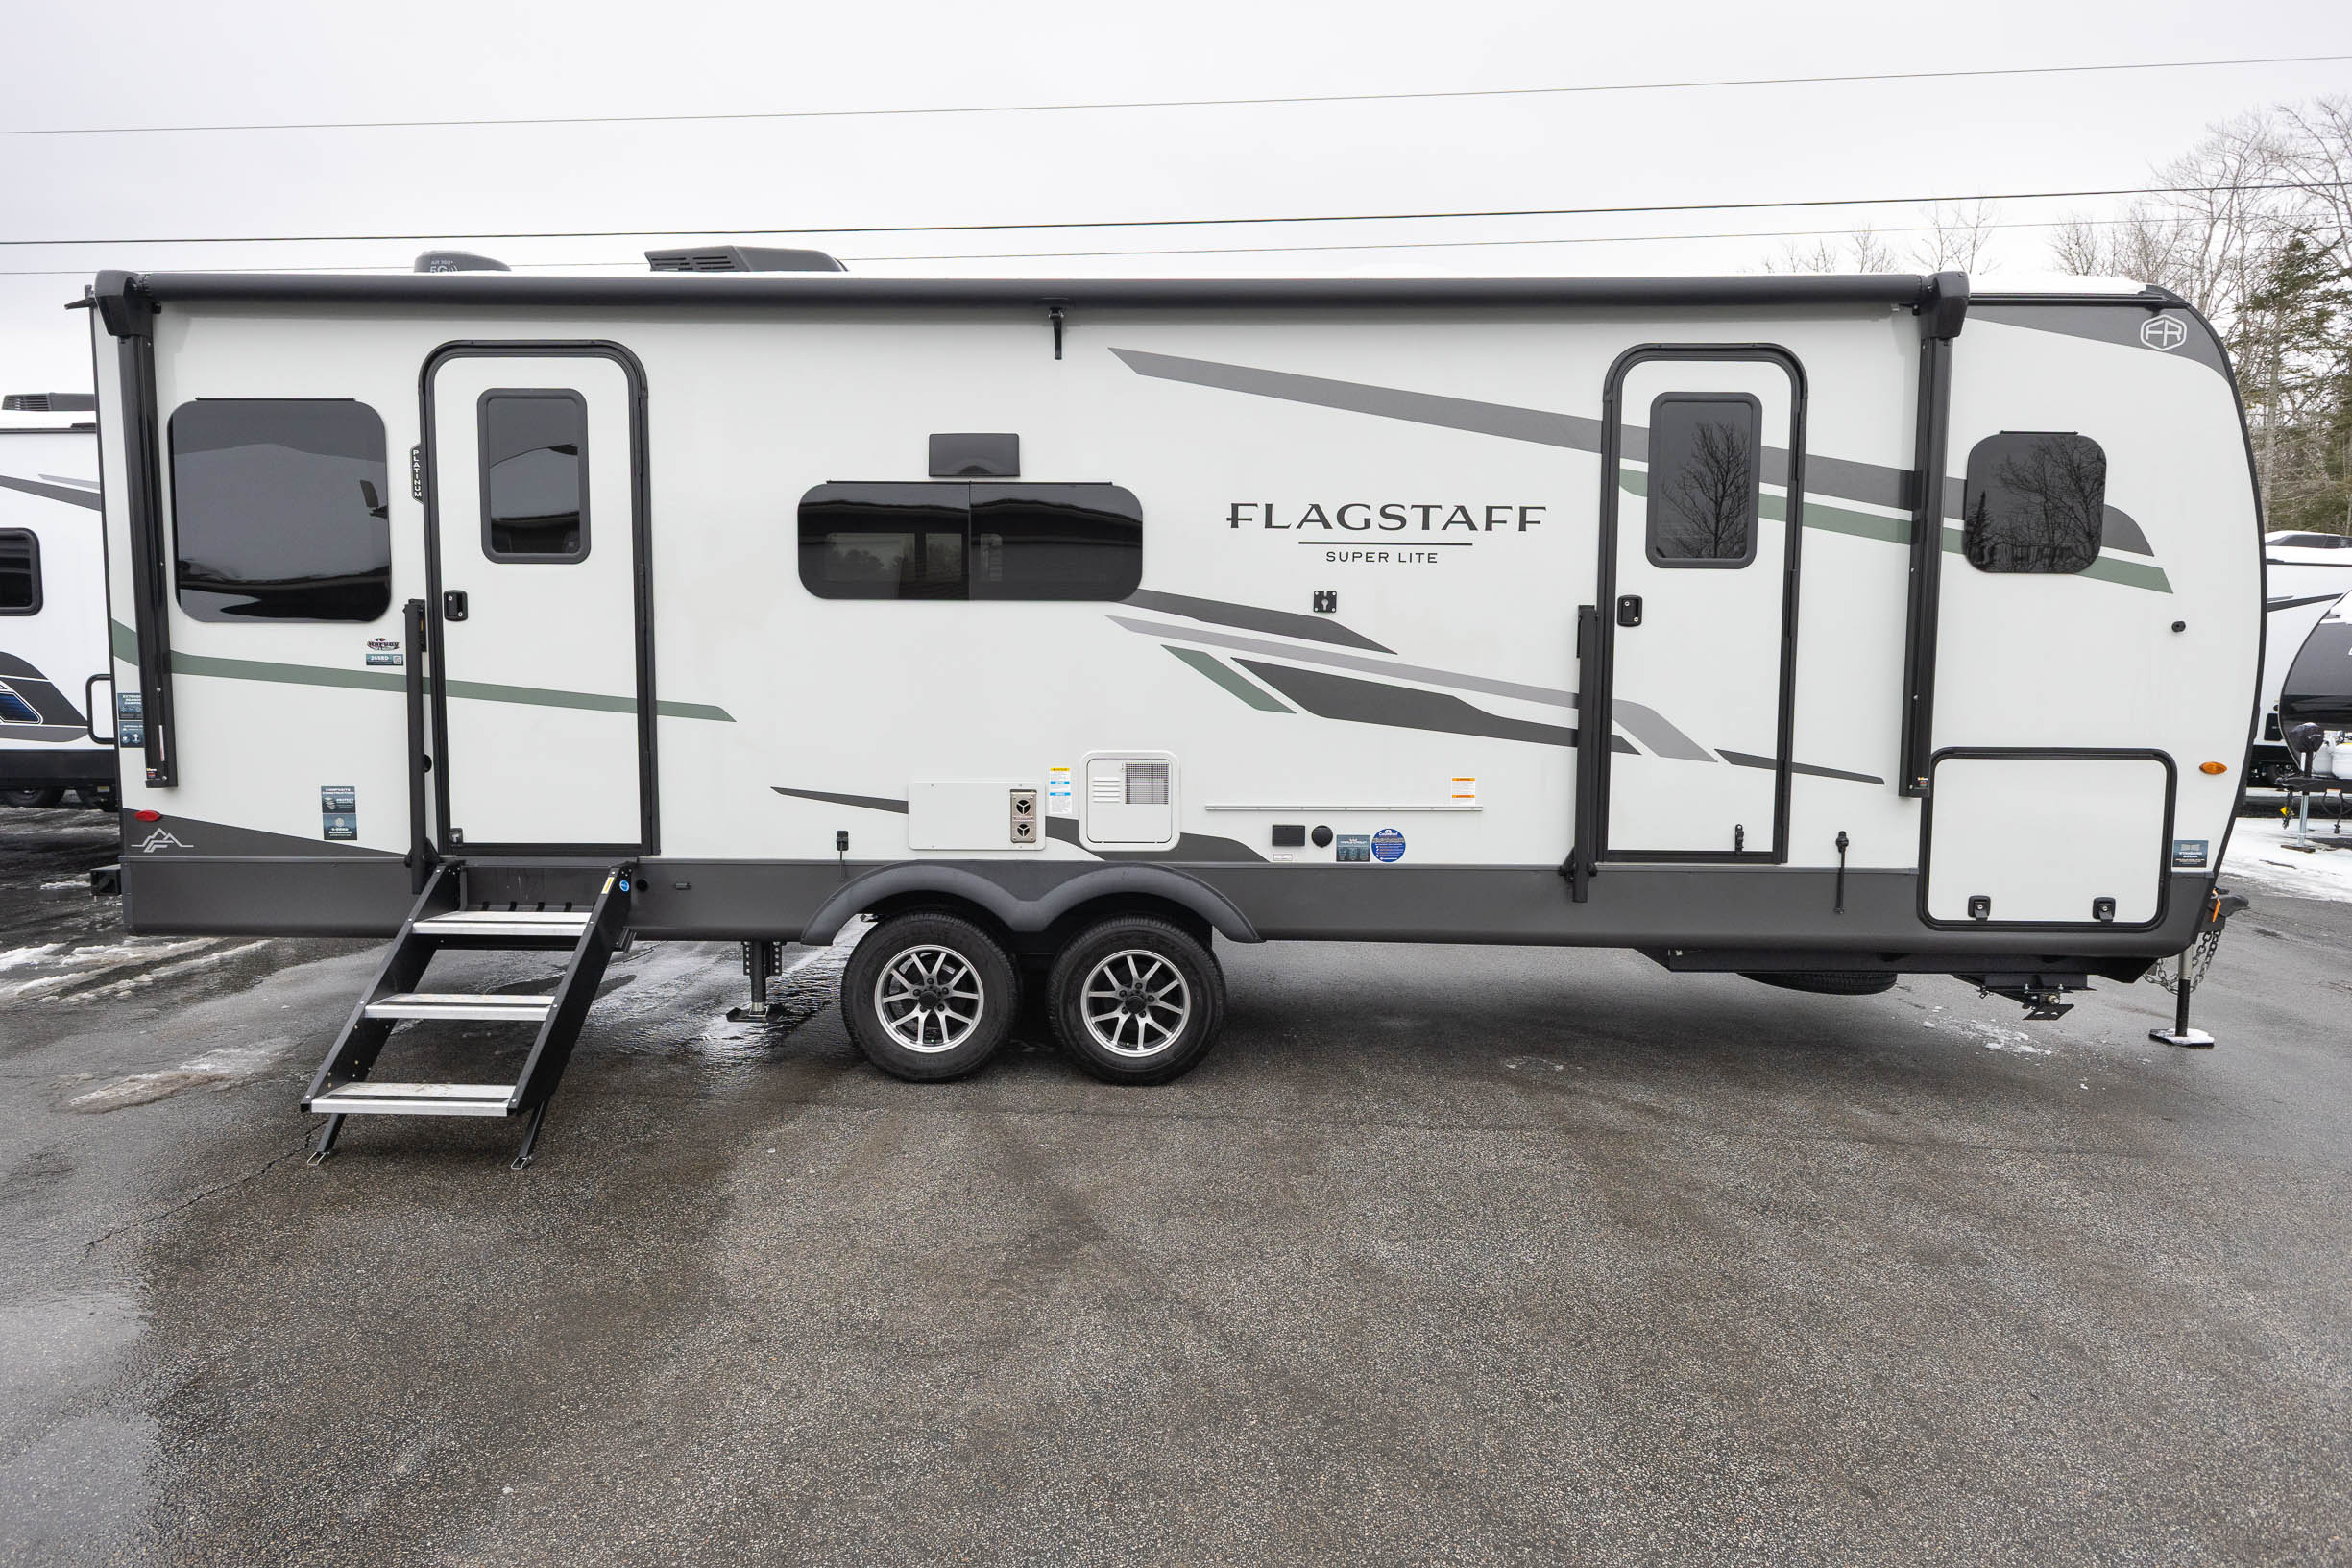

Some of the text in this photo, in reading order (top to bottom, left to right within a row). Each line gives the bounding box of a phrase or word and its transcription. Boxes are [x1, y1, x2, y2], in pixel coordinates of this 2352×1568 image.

[413, 449, 422, 497] PLATINUM
[1226, 502, 1546, 532] FLAGSTAFF
[1325, 551, 1439, 564] SUPER LITE
